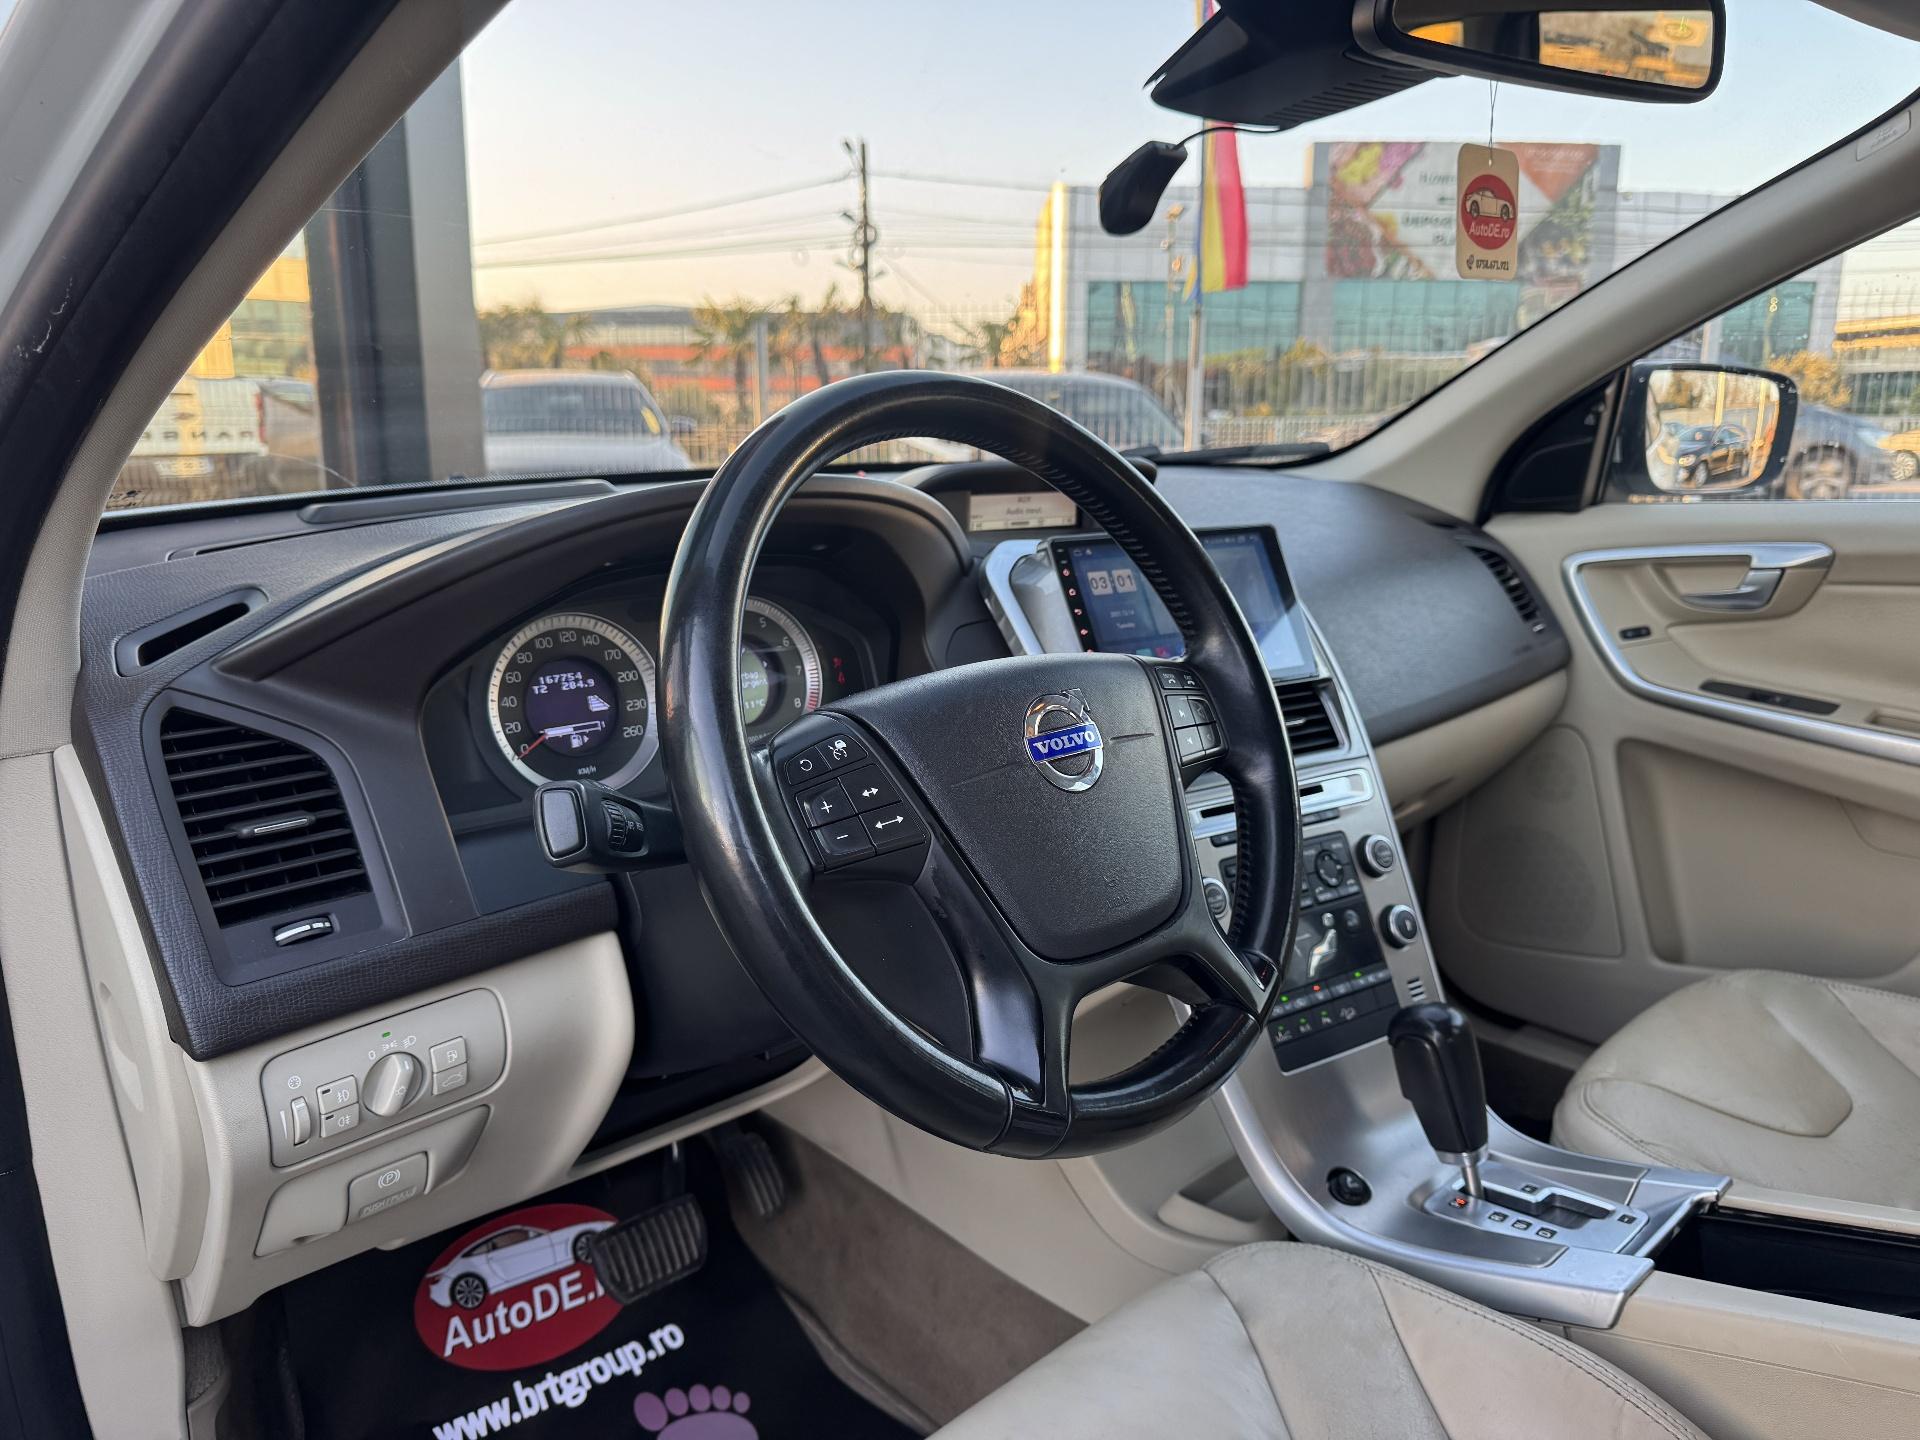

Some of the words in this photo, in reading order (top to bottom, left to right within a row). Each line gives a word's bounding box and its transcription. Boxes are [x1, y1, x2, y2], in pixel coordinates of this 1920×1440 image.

[1468, 221, 1511, 239] AutoDE.ro
[759, 617, 767, 628] 5
[535, 637, 553, 650] 100
[560, 630, 577, 644] 120
[582, 634, 600, 647] 140
[782, 636, 790, 647] 6
[516, 652, 533, 664] 80
[604, 648, 622, 661] 170
[617, 670, 639, 683] 200
[795, 665, 802, 675] 7
[505, 672, 522, 684] 60
[539, 671, 583, 685] 167754
[532, 684, 549, 695] T2
[562, 678, 595, 691] 284.9
[501, 695, 518, 708] 40
[626, 698, 647, 712] 230
[793, 698, 802, 708] 8
[505, 722, 522, 735] 20
[623, 725, 644, 738] 260
[1033, 731, 1095, 754] VOLVO
[577, 765, 597, 776] KM/H
[432, 1323, 685, 1440] www.brtgroup.ro
